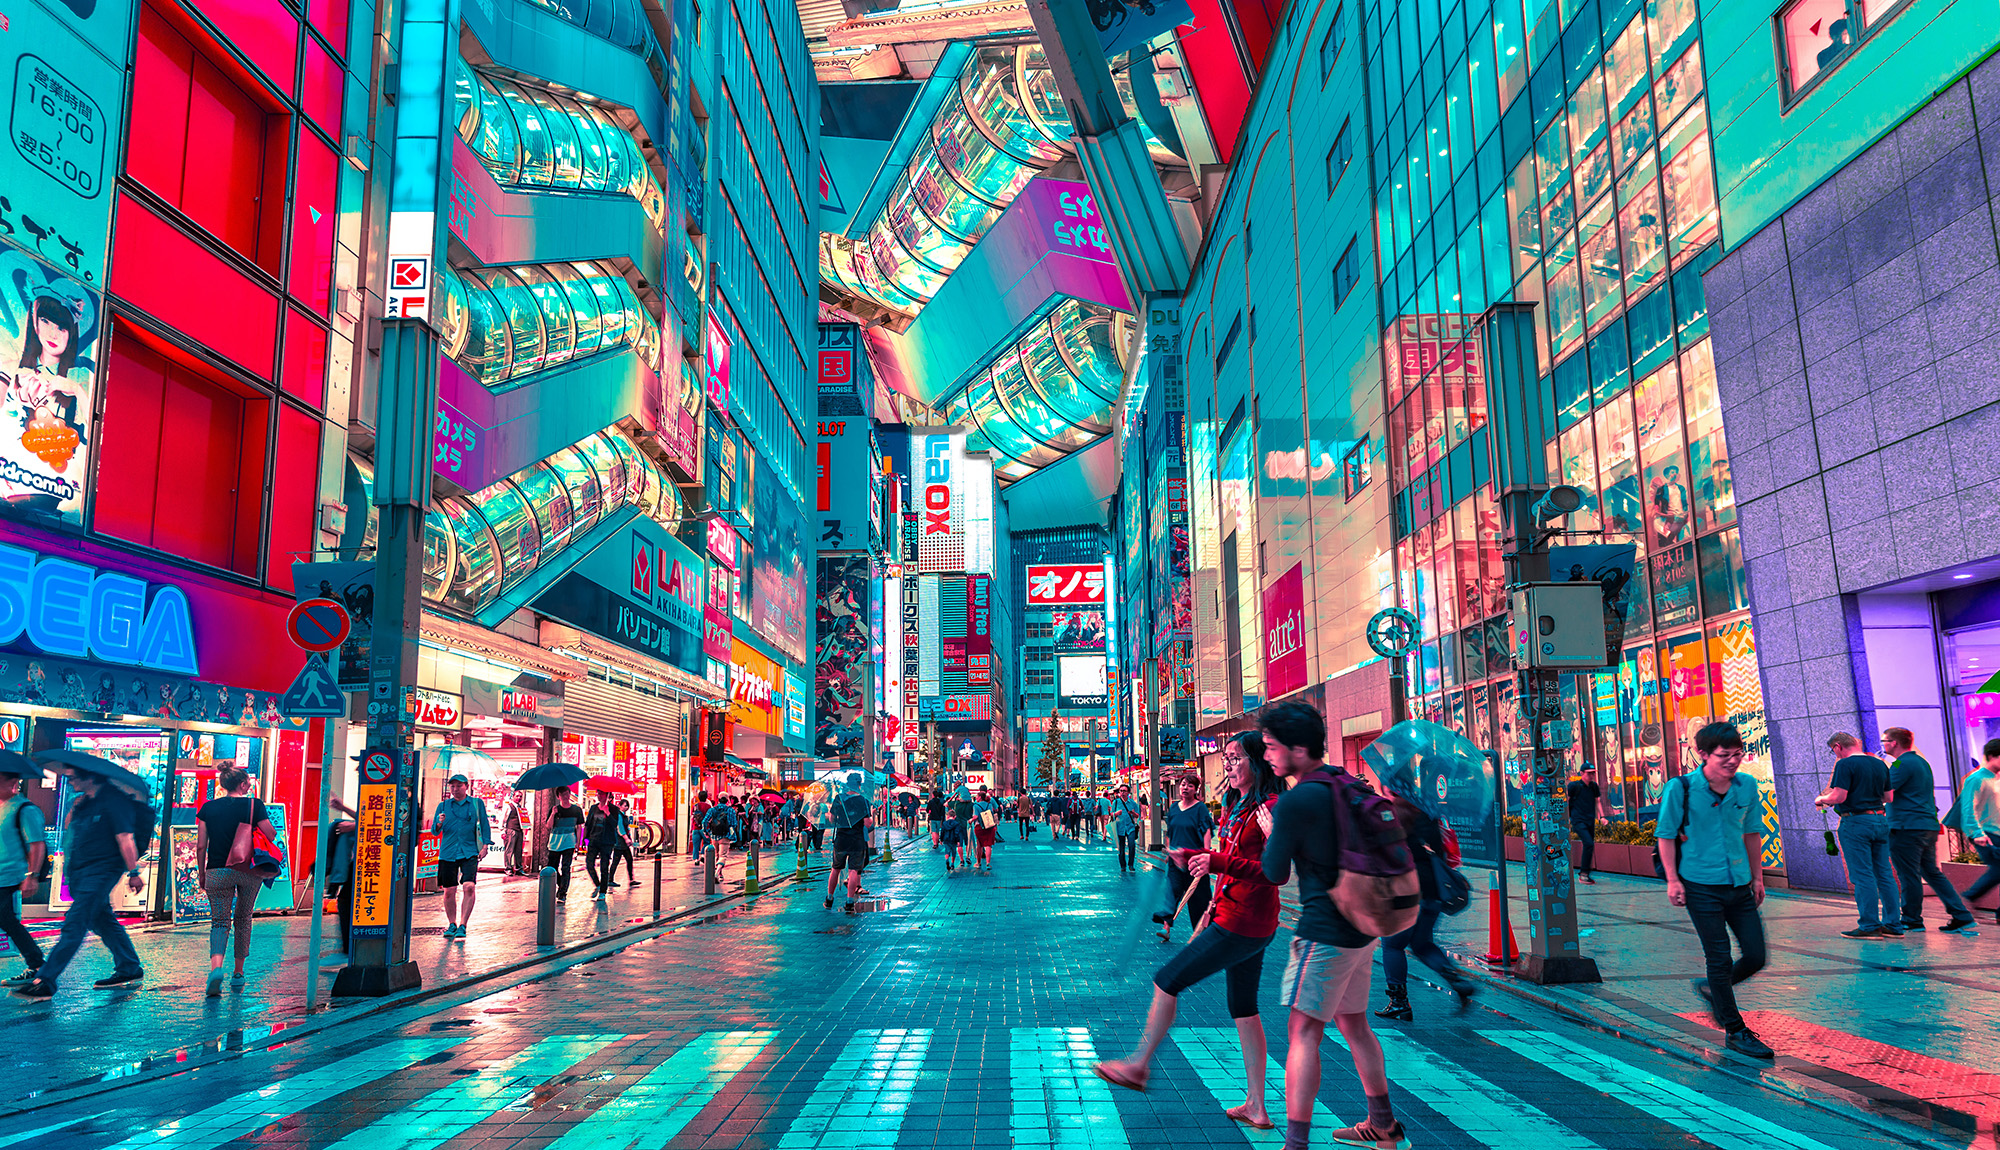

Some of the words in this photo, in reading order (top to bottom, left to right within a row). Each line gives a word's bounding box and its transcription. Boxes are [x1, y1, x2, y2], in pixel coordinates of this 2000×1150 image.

[27, 83, 94, 145] 16:00
[33, 67, 94, 123] 営業時間
[19, 130, 93, 192] 翌5:00
[1053, 220, 1109, 253] カメラ
[436, 409, 476, 452] カメラ
[435, 442, 463, 472] メラ
[1171, 502, 1180, 510] 6F
[708, 519, 735, 562] アコム
[904, 514, 912, 560] PARADISE
[910, 514, 918, 545] HOBBY
[657, 547, 702, 612] LABI
[975, 578, 989, 606] Duty
[656, 595, 702, 633] AKIHABARA
[975, 608, 989, 636] Free
[1269, 608, 1296, 660] atré
[513, 692, 537, 711] LABI
[384, 788, 394, 831] 千代田区内は
[363, 794, 385, 922] 路上喫煙禁止です。
[422, 838, 441, 852] au
[359, 927, 387, 936] 千代田区
